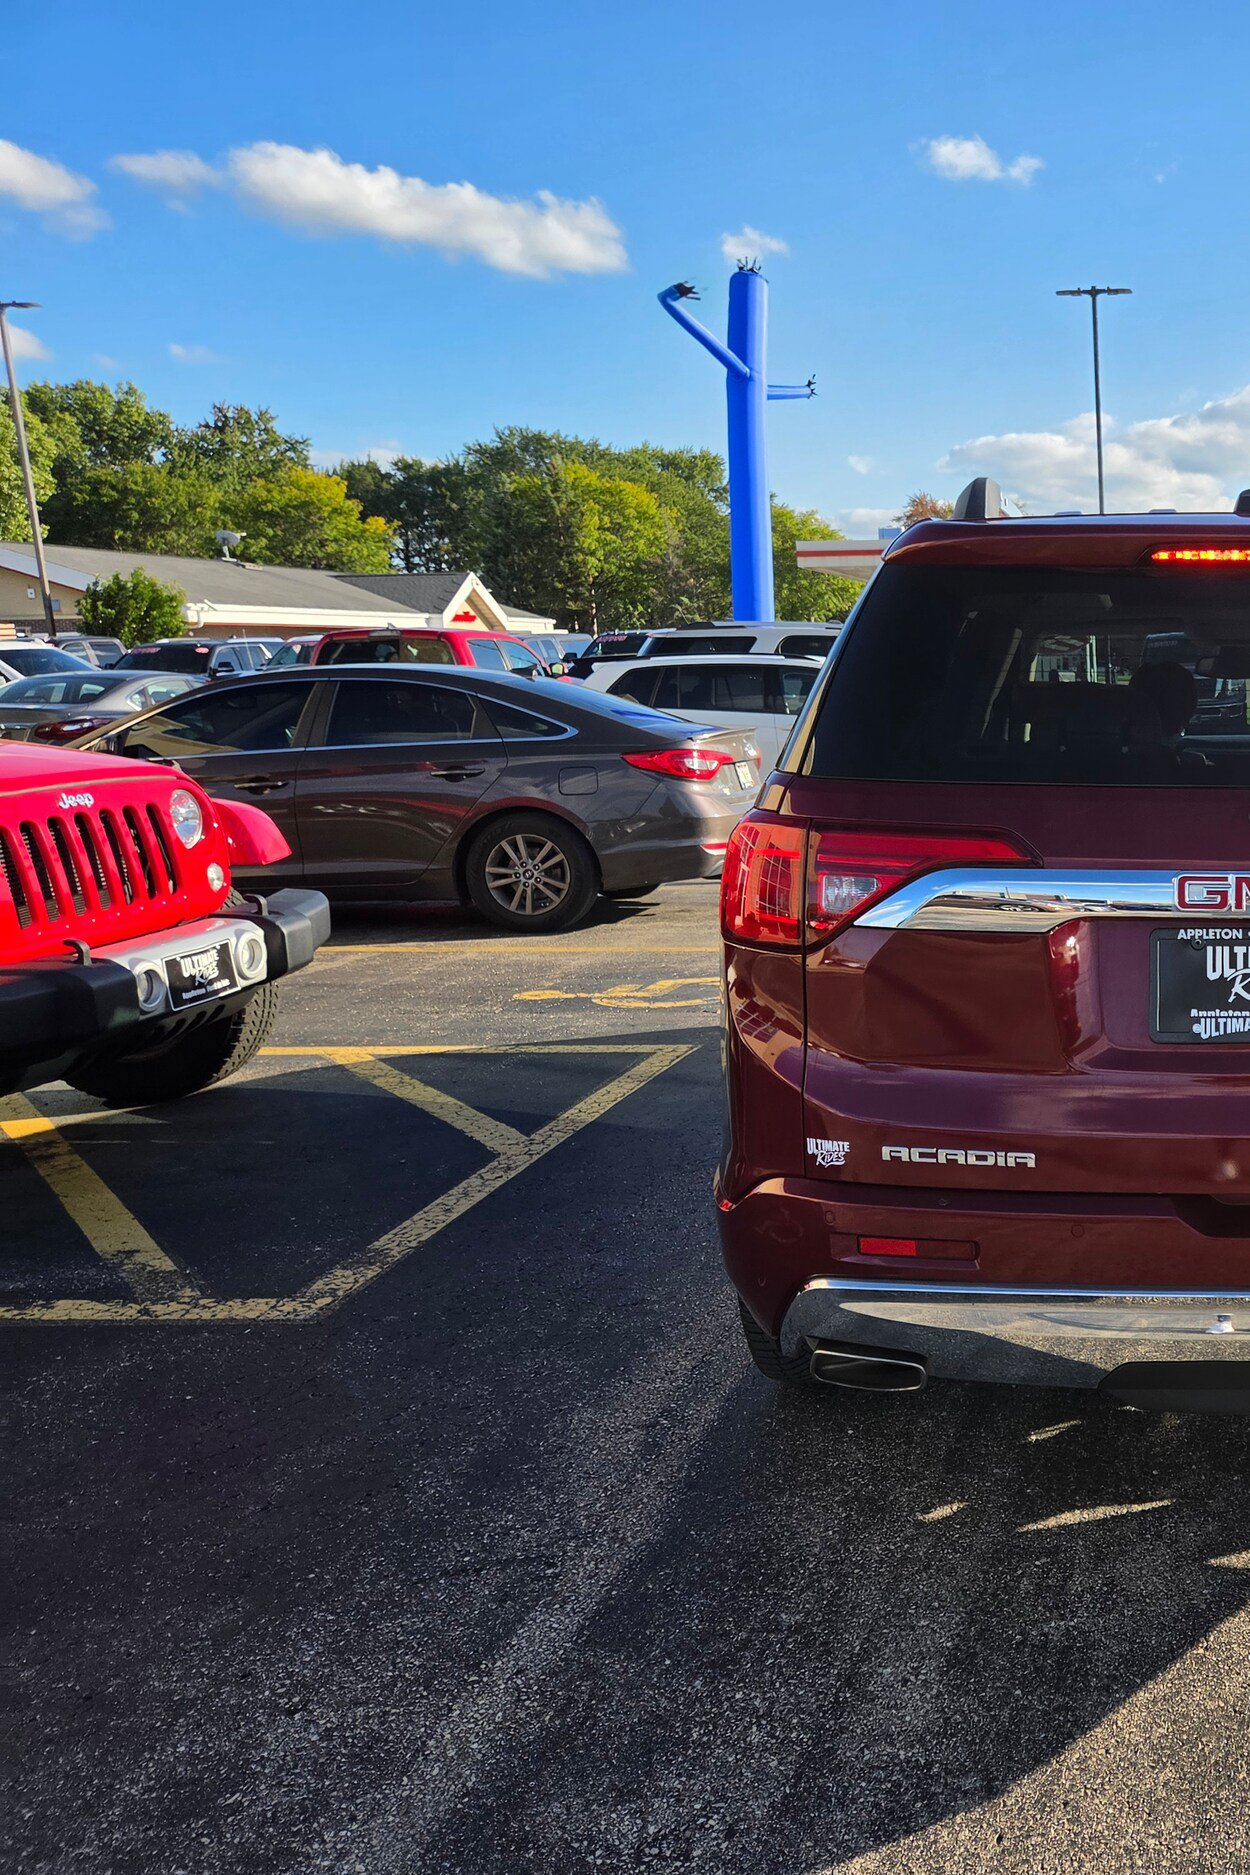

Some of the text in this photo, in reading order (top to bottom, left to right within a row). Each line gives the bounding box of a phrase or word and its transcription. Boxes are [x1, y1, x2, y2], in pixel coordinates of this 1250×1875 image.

[58, 792, 94, 809] Jeep
[1177, 929, 1243, 939] APPLETON
[806, 1137, 850, 1155] ULTIMATE
[882, 1145, 1036, 1168] ACADIA
